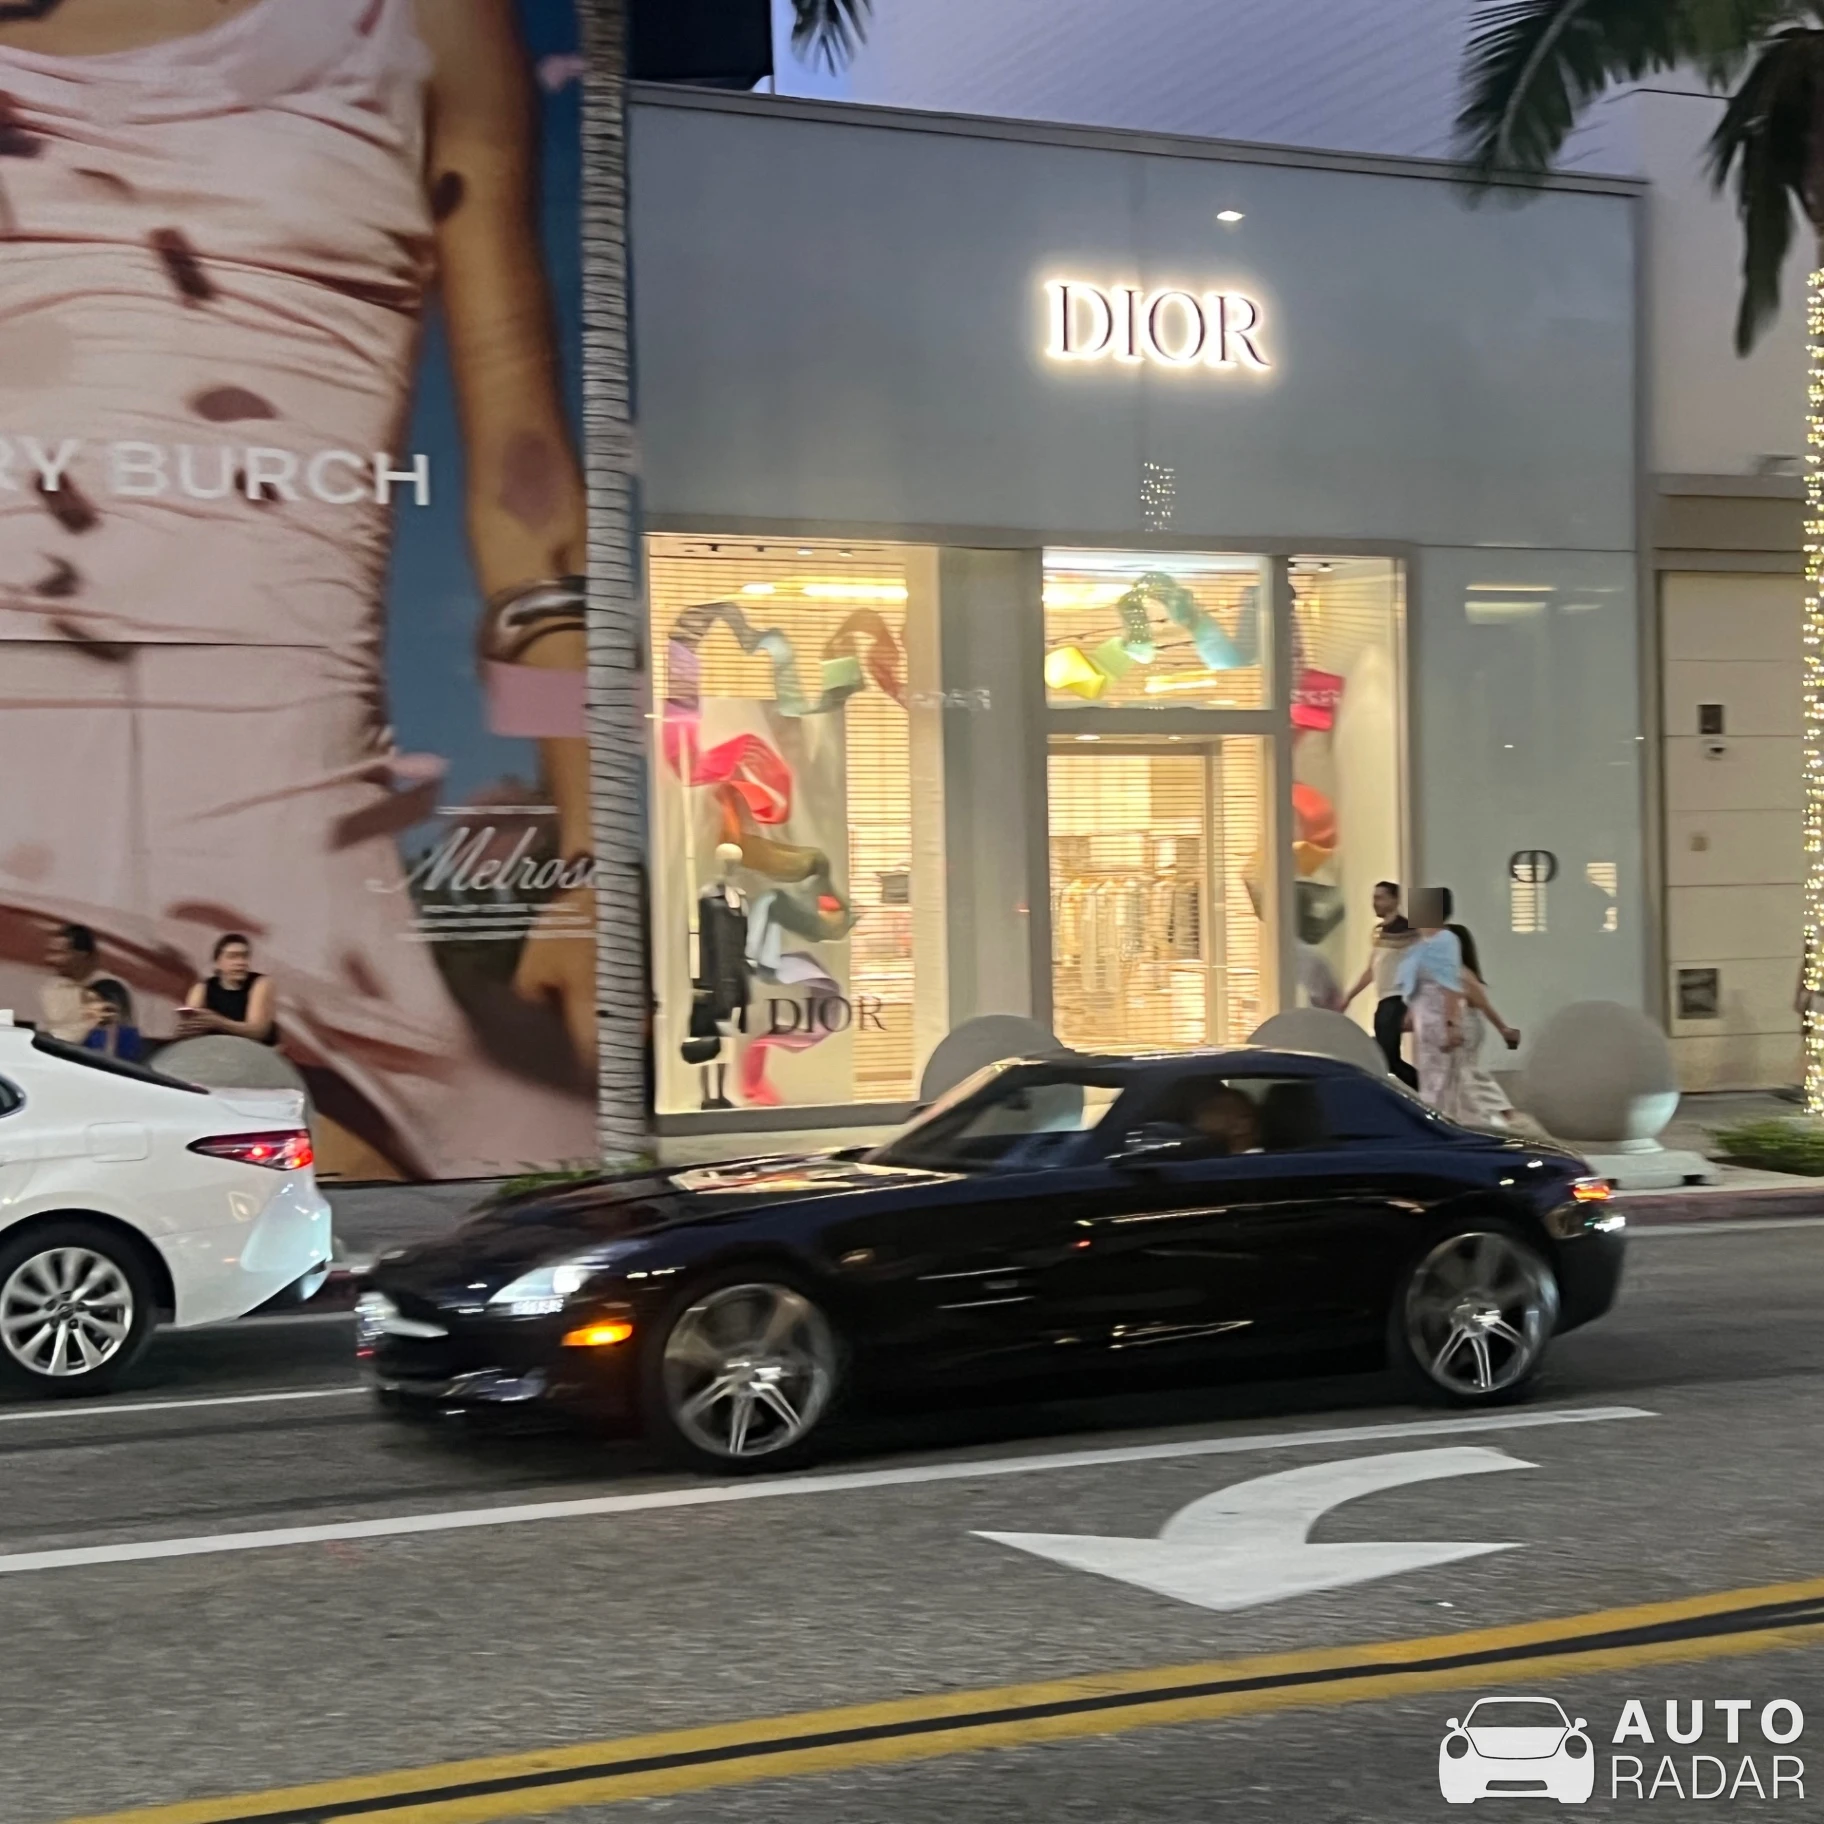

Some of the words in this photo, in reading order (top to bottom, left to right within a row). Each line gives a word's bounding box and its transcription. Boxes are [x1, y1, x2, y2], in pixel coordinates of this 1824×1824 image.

[1045, 280, 1271, 370] DIOR
[114, 441, 430, 506] BURCH
[766, 995, 887, 1035] DIOR
